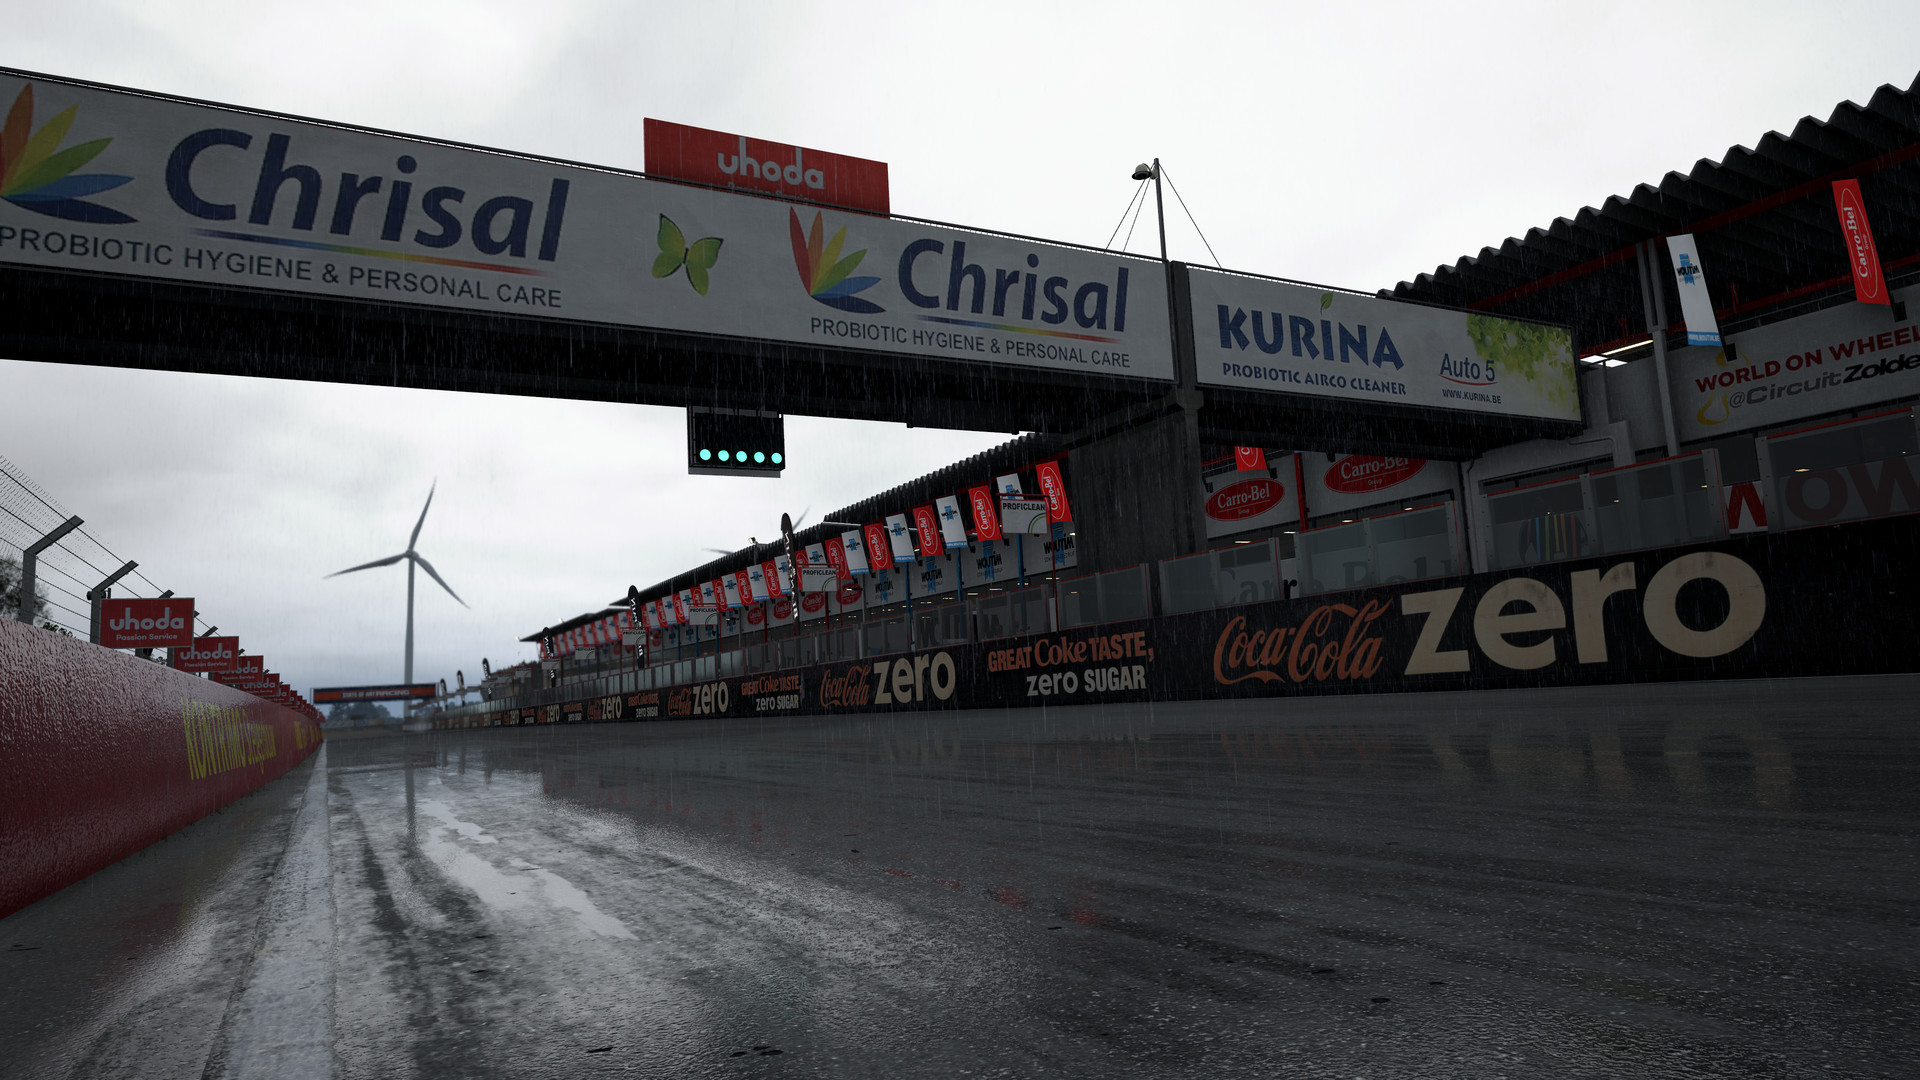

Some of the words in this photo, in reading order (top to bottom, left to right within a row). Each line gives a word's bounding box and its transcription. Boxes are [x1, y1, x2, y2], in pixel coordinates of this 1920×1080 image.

[717, 135, 825, 190] uhoda
[165, 128, 570, 261] Chrisal
[1844, 206, 1869, 278] Carro-Bel
[0, 226, 173, 265] PROBIOTIC
[184, 247, 312, 281] HYGIENE
[322, 263, 338, 284] &
[350, 266, 489, 300] PERSONAL
[496, 283, 561, 308] CARE
[898, 238, 1129, 332] Chrisal
[810, 317, 907, 344] PROBIOTIC
[913, 330, 985, 353] HYGIENE
[990, 338, 1001, 354] &
[1006, 340, 1087, 364] PERSONAL
[1091, 350, 1131, 368] CARE
[1217, 304, 1404, 371] KURINA
[1223, 362, 1300, 384] PROBIOTIC
[1304, 372, 1347, 389] AIRCO
[1350, 377, 1407, 396] CLEANER
[1440, 353, 1481, 380] Auto
[1485, 360, 1496, 382] 5
[1695, 361, 1781, 393] WORLD
[1785, 349, 1823, 373] ON
[1442, 388, 1502, 404] WWW.KURINA.BE
[1340, 457, 1409, 480] Carro-Bel
[1002, 502, 1046, 512] PROFICLEAN
[1043, 475, 1059, 511] Carro-Bel
[1217, 482, 1270, 509] Carro-Bel
[109, 607, 184, 630] uhoda
[1213, 598, 1393, 685] Coca-Cola
[1401, 551, 1766, 676] zero
[116, 634, 148, 642] Passion
[149, 632, 178, 640] Service
[180, 642, 232, 660] uhoda
[988, 647, 1032, 673] GREAT
[1034, 636, 1088, 667] Coke
[1088, 631, 1155, 662] TASTE,
[759, 675, 779, 694] Coke
[820, 665, 872, 708] Coca-Cola
[873, 651, 956, 705] zero
[1026, 671, 1079, 697] zero
[1083, 665, 1147, 693] SUGAR
[601, 696, 622, 720] zero
[693, 681, 729, 715] zero
[756, 696, 776, 711] zero
[776, 694, 799, 710] SUGAR
